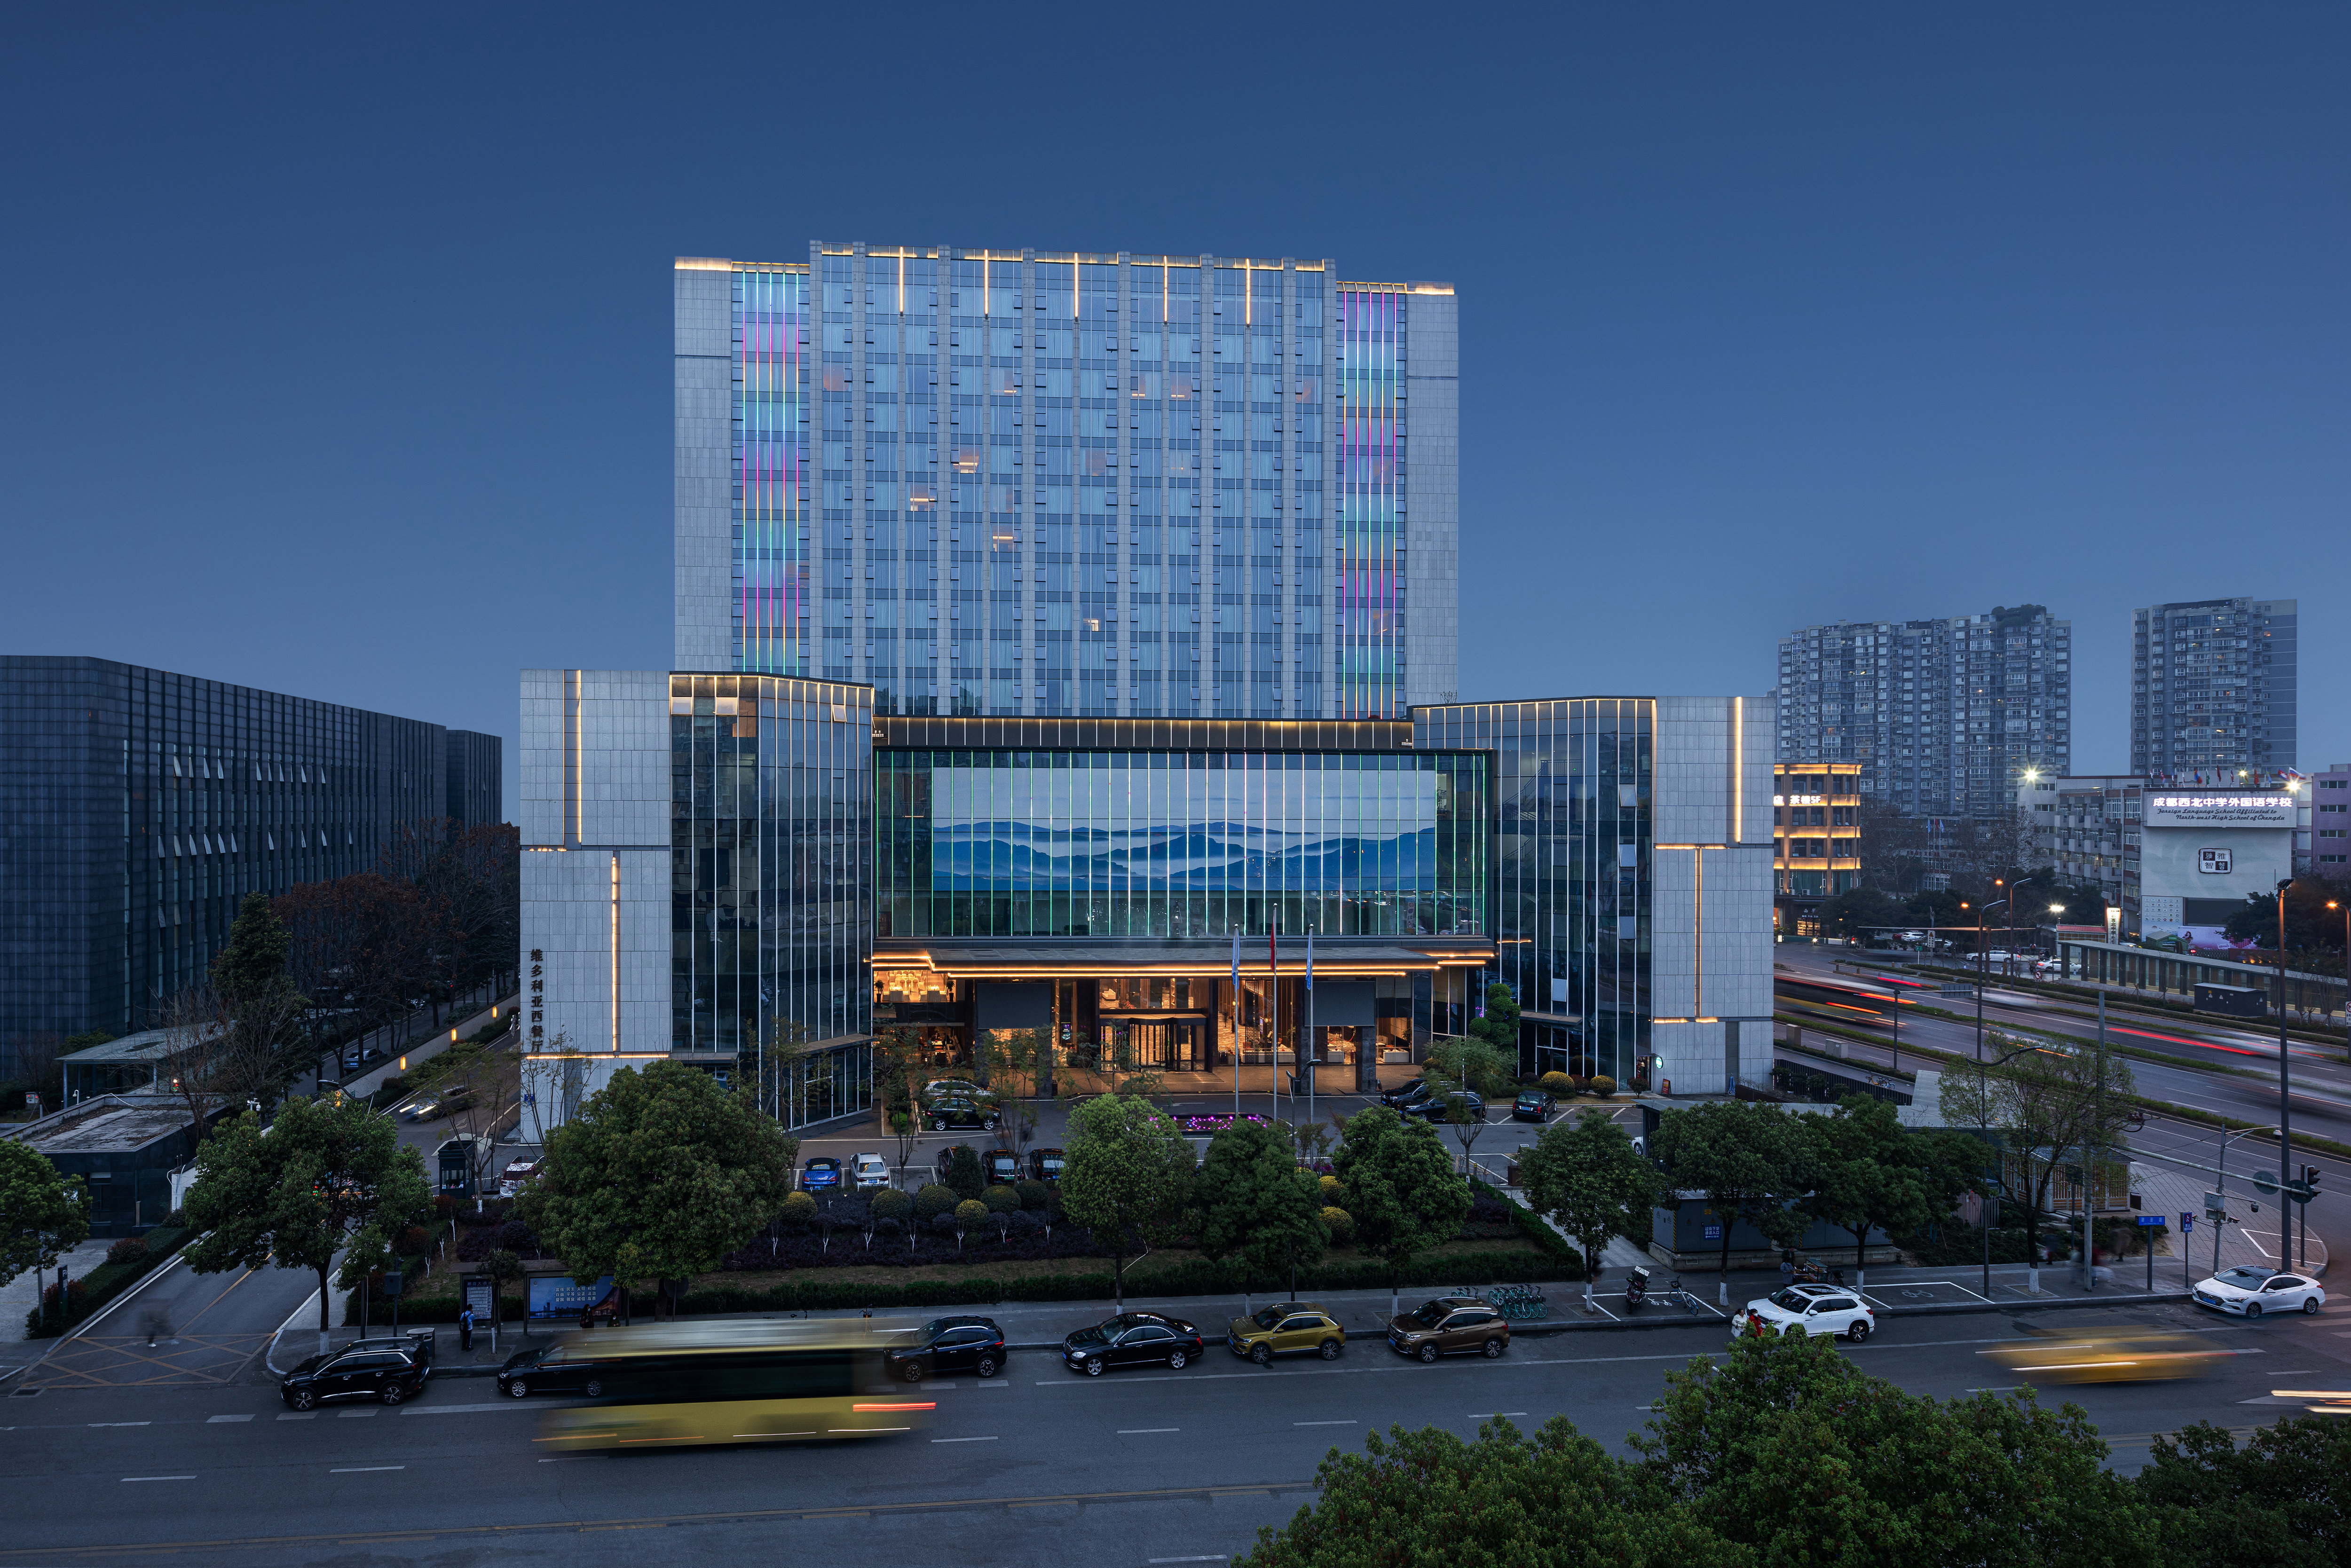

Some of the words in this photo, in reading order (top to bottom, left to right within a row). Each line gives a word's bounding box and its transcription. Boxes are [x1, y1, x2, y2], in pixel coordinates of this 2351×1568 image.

[2153, 797, 2293, 807] 成都西北中学外国语学校
[530, 949, 543, 1053] 维多利亚西餐厅
